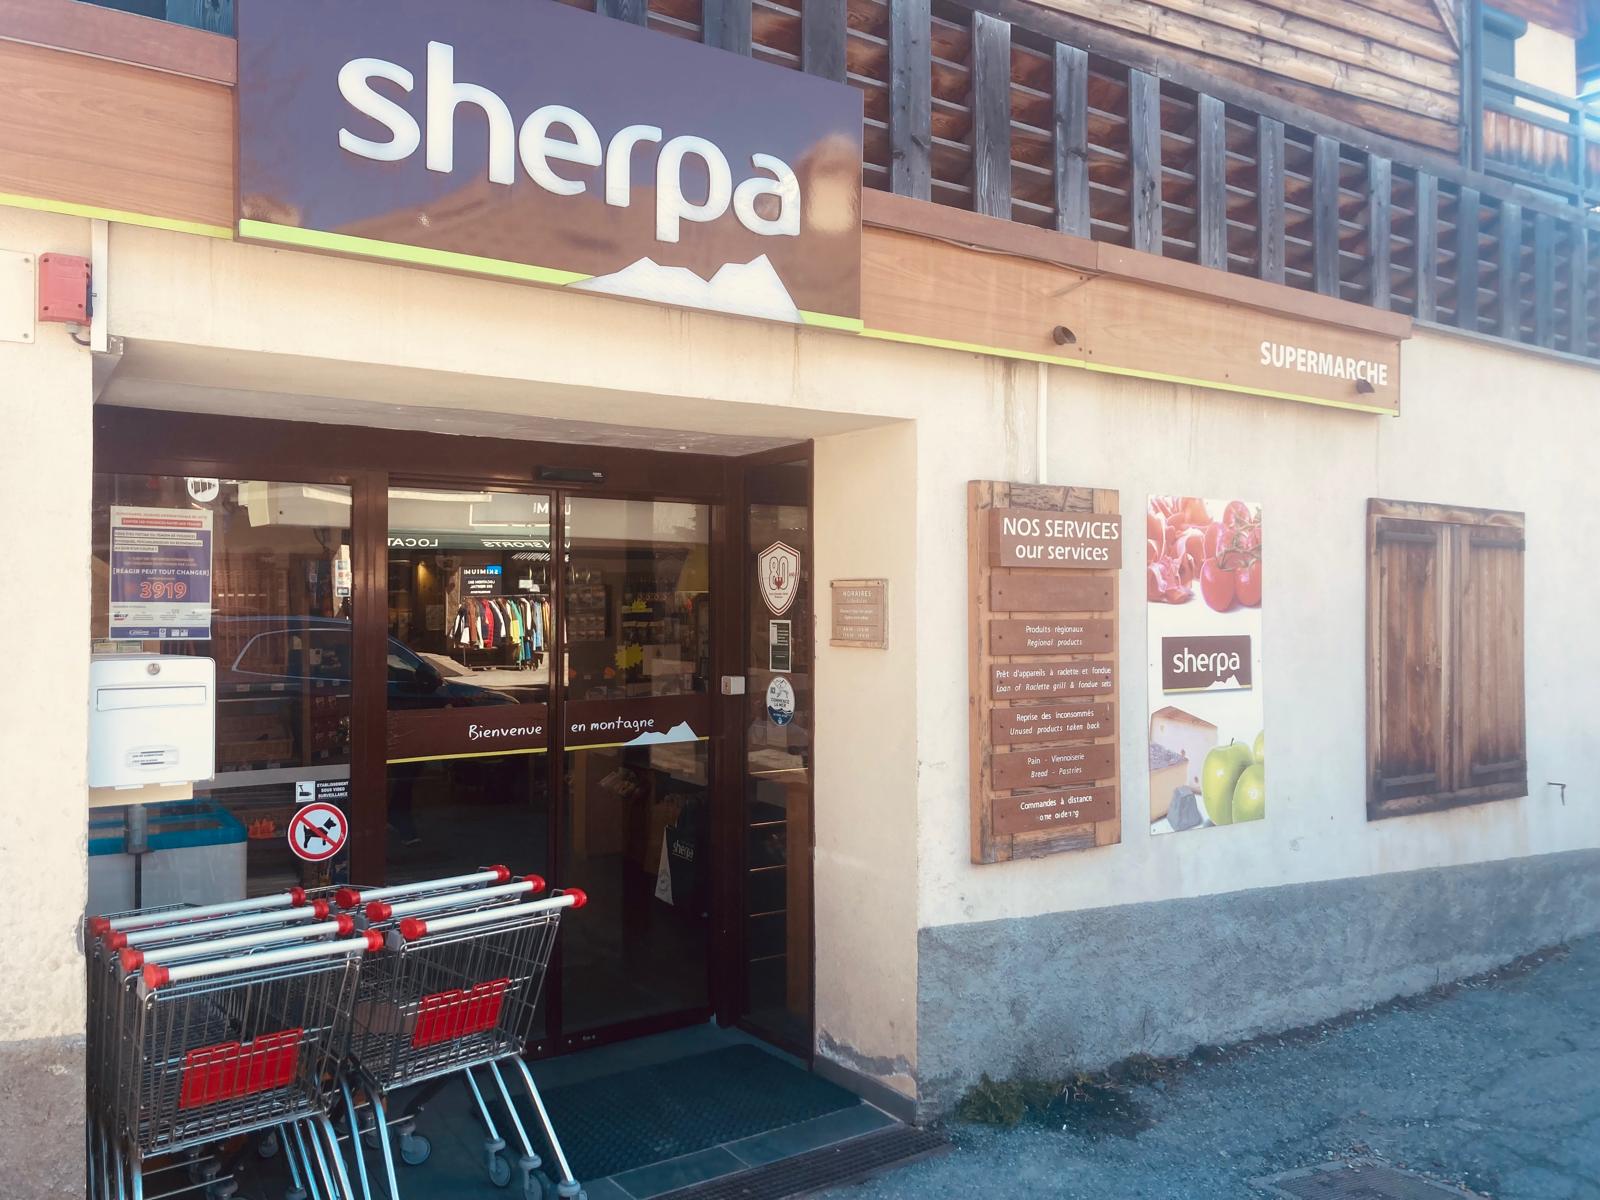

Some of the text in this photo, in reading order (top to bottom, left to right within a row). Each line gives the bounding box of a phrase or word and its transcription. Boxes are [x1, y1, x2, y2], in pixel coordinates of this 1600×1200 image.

[337, 40, 801, 243] sherpa
[1260, 341, 1388, 386] SUPERMARCHE
[1003, 517, 1119, 540] NOS SERVICES
[1015, 543, 1109, 561] our services
[140, 581, 187, 599] 3919
[1025, 624, 1051, 633] Produits
[1027, 638, 1083, 648] Regional products
[1172, 647, 1240, 677] sherpa
[1057, 667, 1079, 676] raclette
[1092, 666, 1112, 674] fondue
[996, 684, 1011, 692] Loan
[1014, 683, 1022, 691] of
[1025, 682, 1051, 691] Raclette
[1078, 680, 1098, 689] fondue
[1102, 680, 1112, 688] sets
[1016, 713, 1038, 722] Reprise
[1041, 711, 1052, 720] des
[468, 716, 655, 741] Bienvenue en montagne
[1010, 721, 1101, 736] Unused products taken back
[1027, 756, 1041, 765] Pain
[1051, 752, 1085, 763] Viennoiserie
[1031, 769, 1049, 778] Bread
[1059, 767, 1082, 776] Pastries
[1020, 799, 1057, 810] Commandes
[1067, 795, 1093, 805] distance
